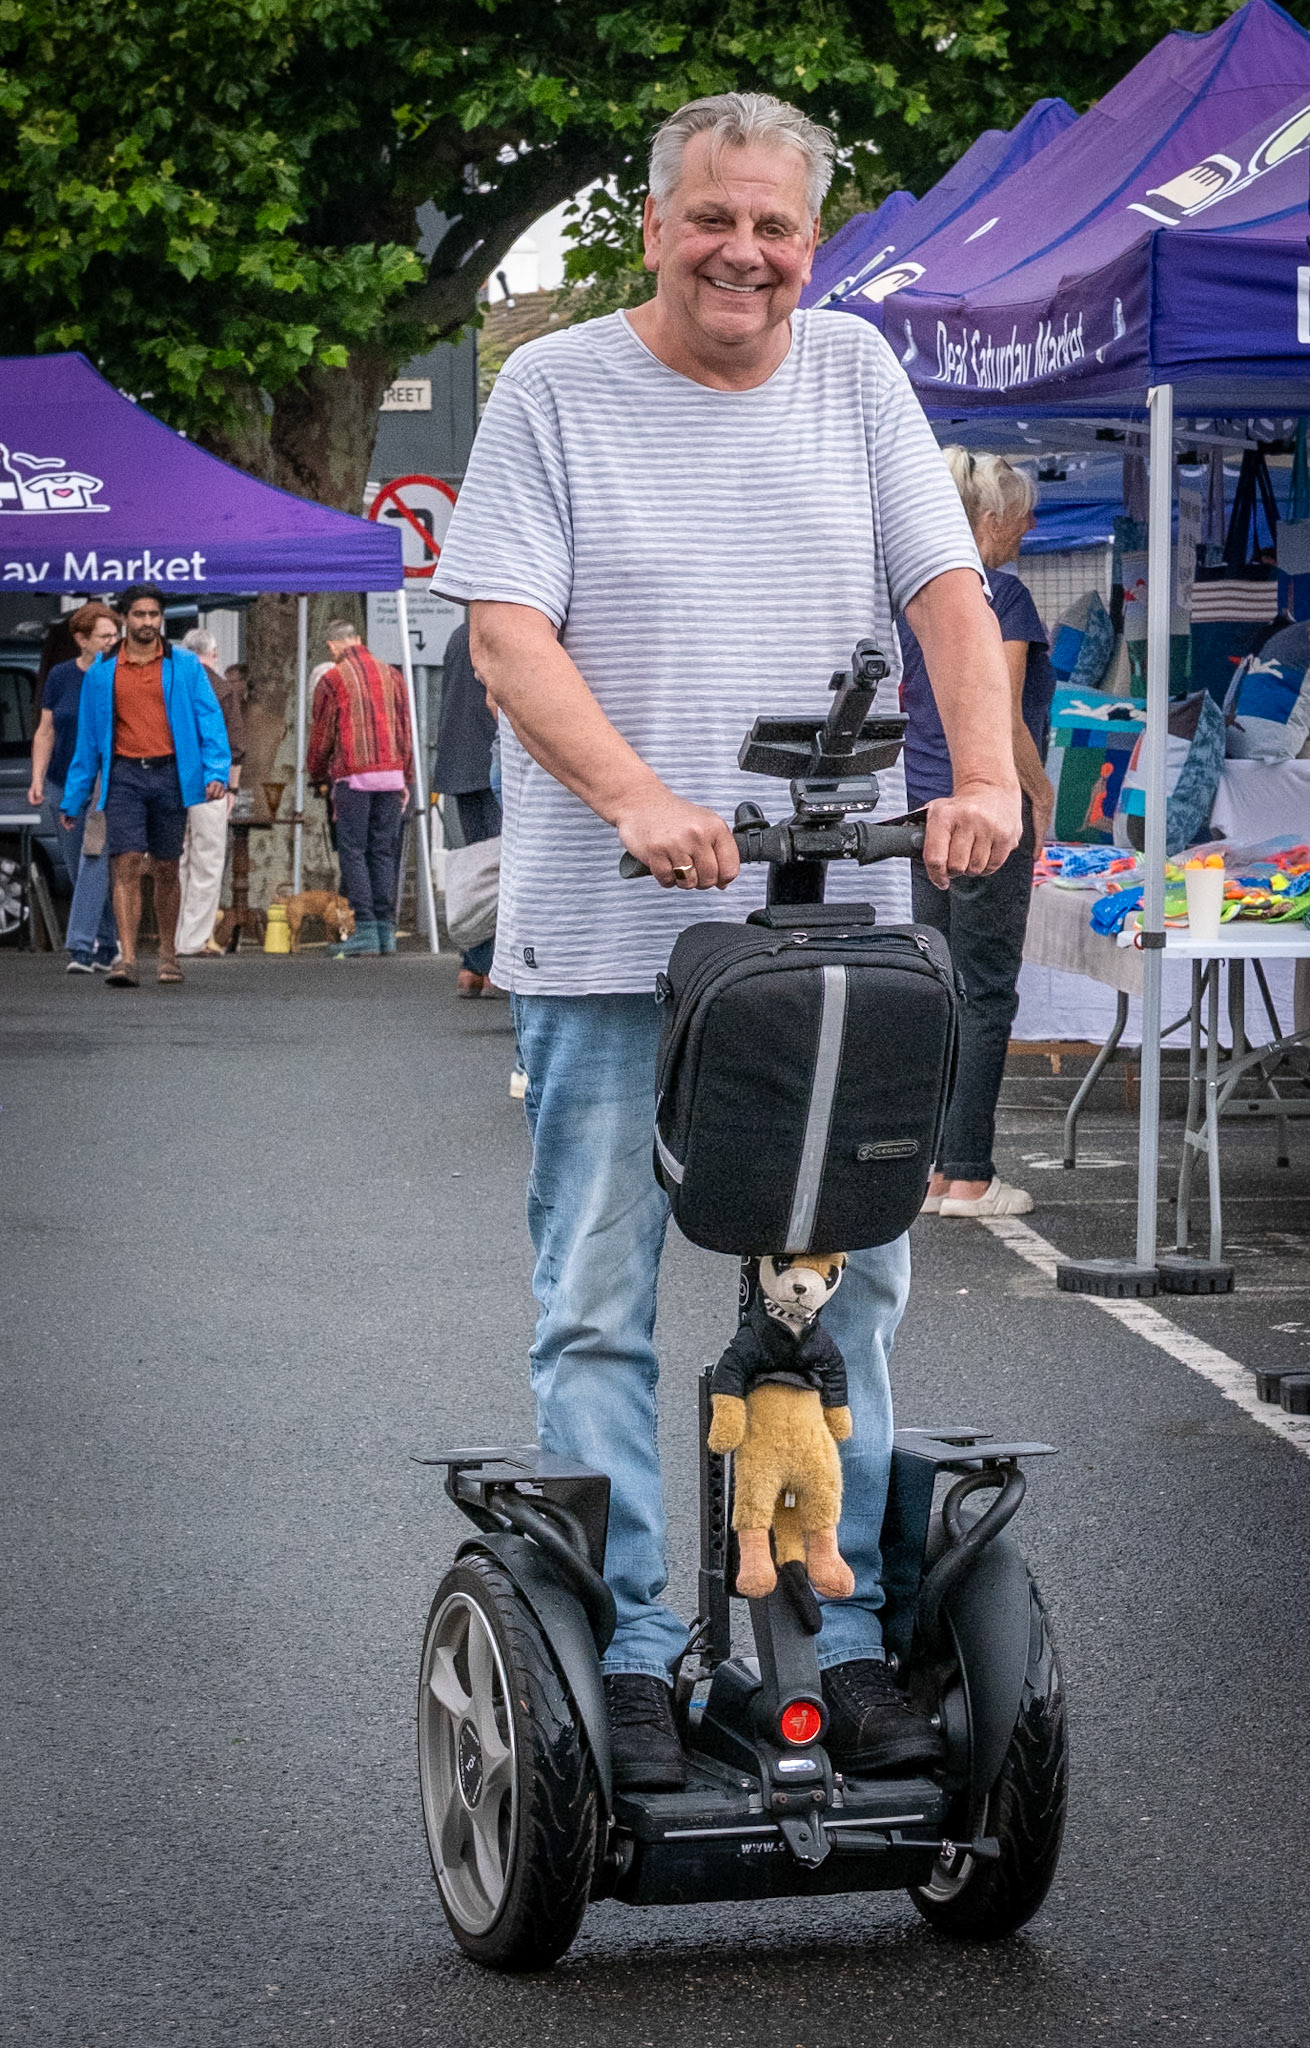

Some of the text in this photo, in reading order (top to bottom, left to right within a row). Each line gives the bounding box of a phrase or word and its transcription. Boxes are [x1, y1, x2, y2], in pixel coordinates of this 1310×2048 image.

[930, 312, 1085, 388] Deal Saturday Market
[64, 549, 207, 582] Market
